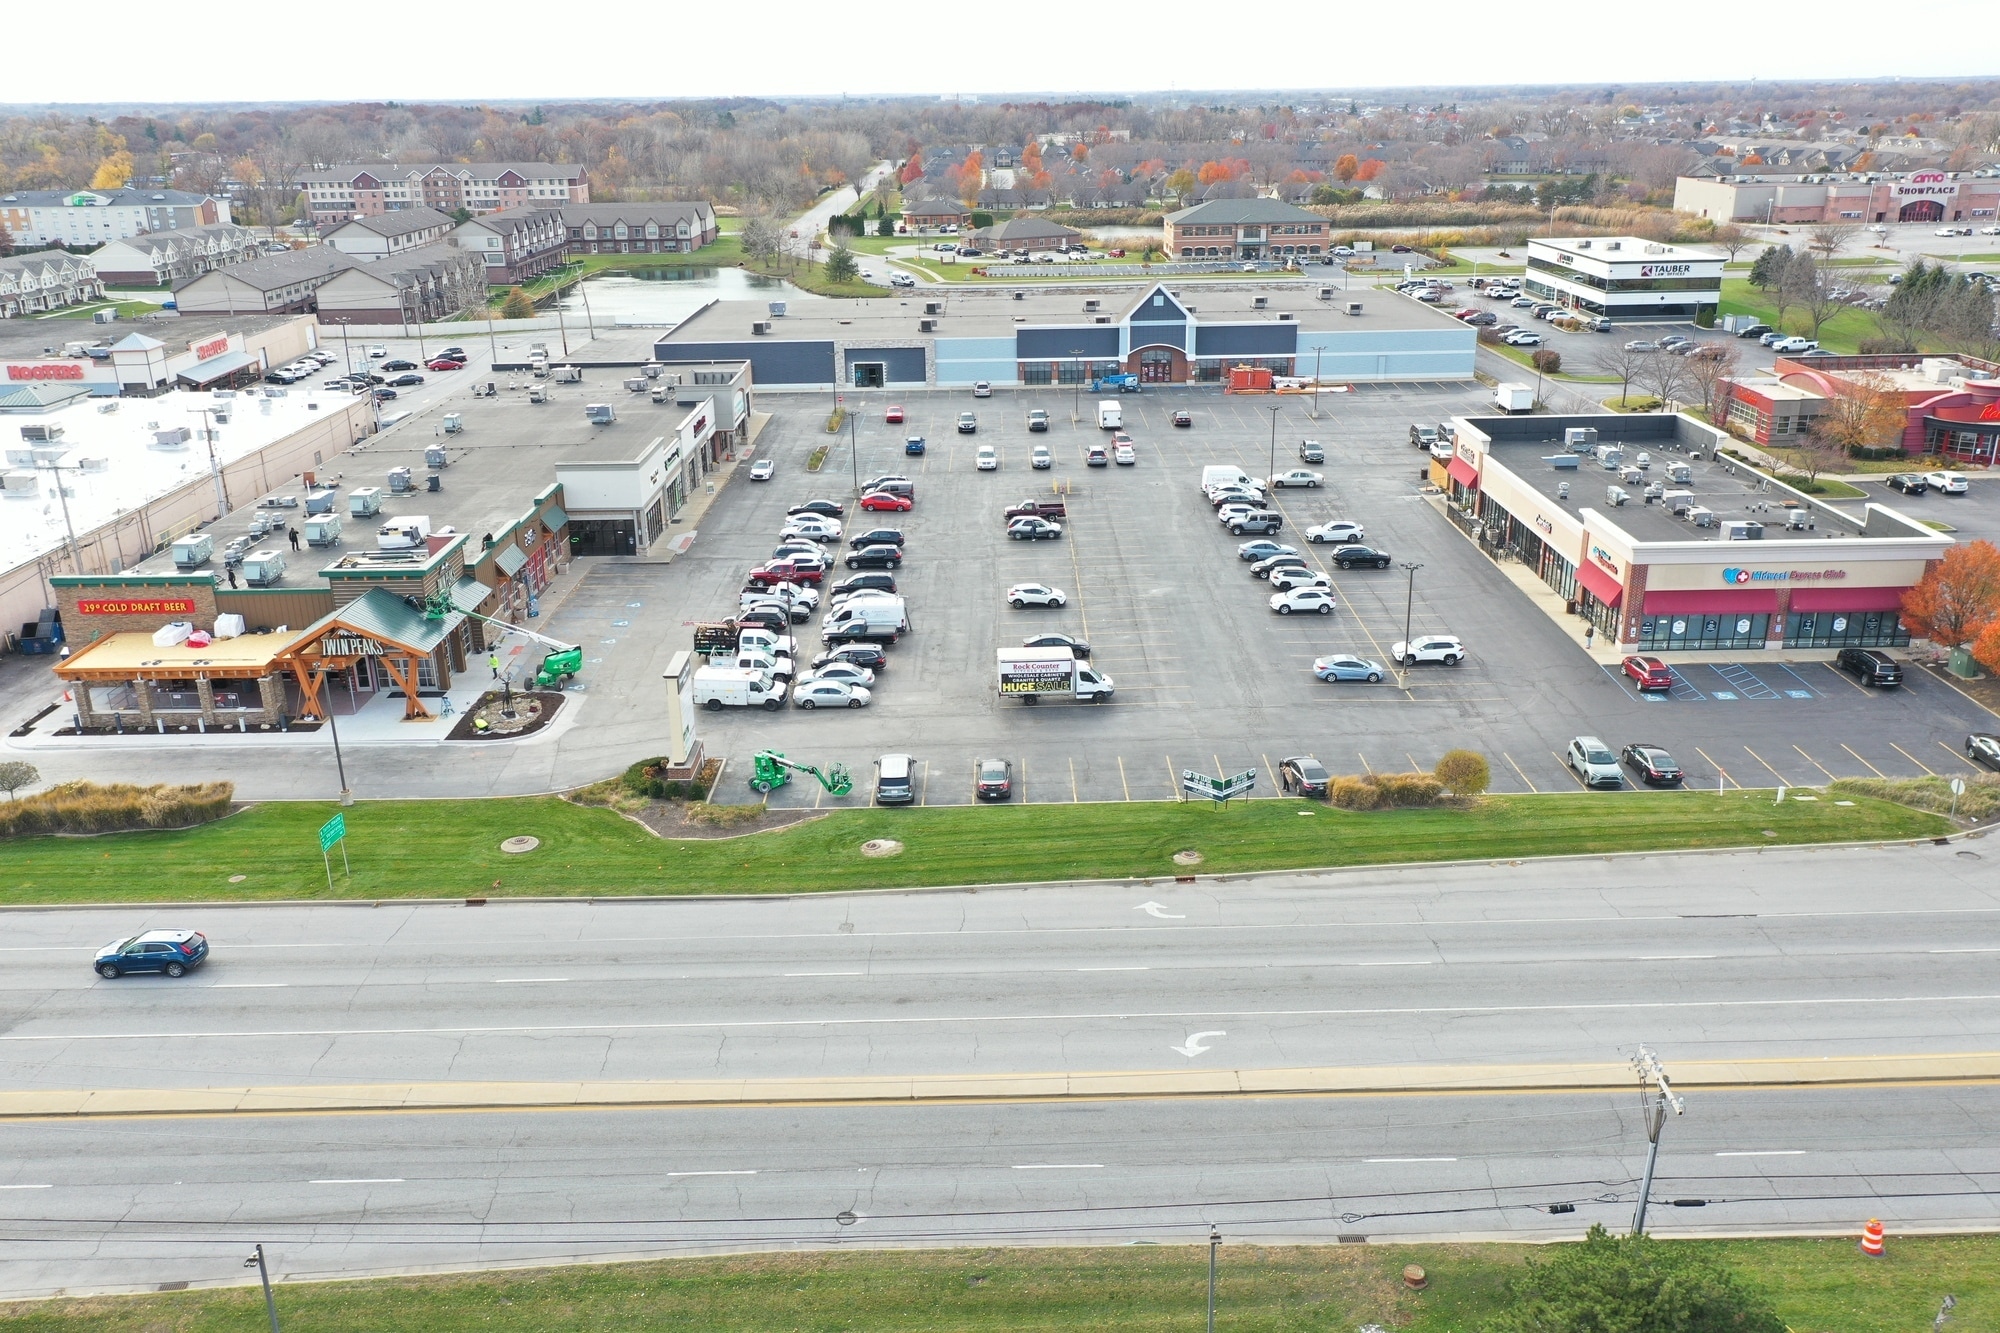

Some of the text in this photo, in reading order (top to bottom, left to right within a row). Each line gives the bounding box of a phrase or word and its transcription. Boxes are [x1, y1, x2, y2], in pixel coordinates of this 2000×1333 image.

[196, 337, 229, 360] HOOTERS
[7, 365, 84, 380] HOOTERS
[1751, 570, 1846, 580] Midwest Express Clinic
[103, 603, 128, 612] COLD
[131, 603, 161, 612] DRAFT
[164, 602, 187, 611] BEER
[321, 638, 384, 656] TWIN PEAKS
[1002, 681, 1070, 692] HUGE SALE
